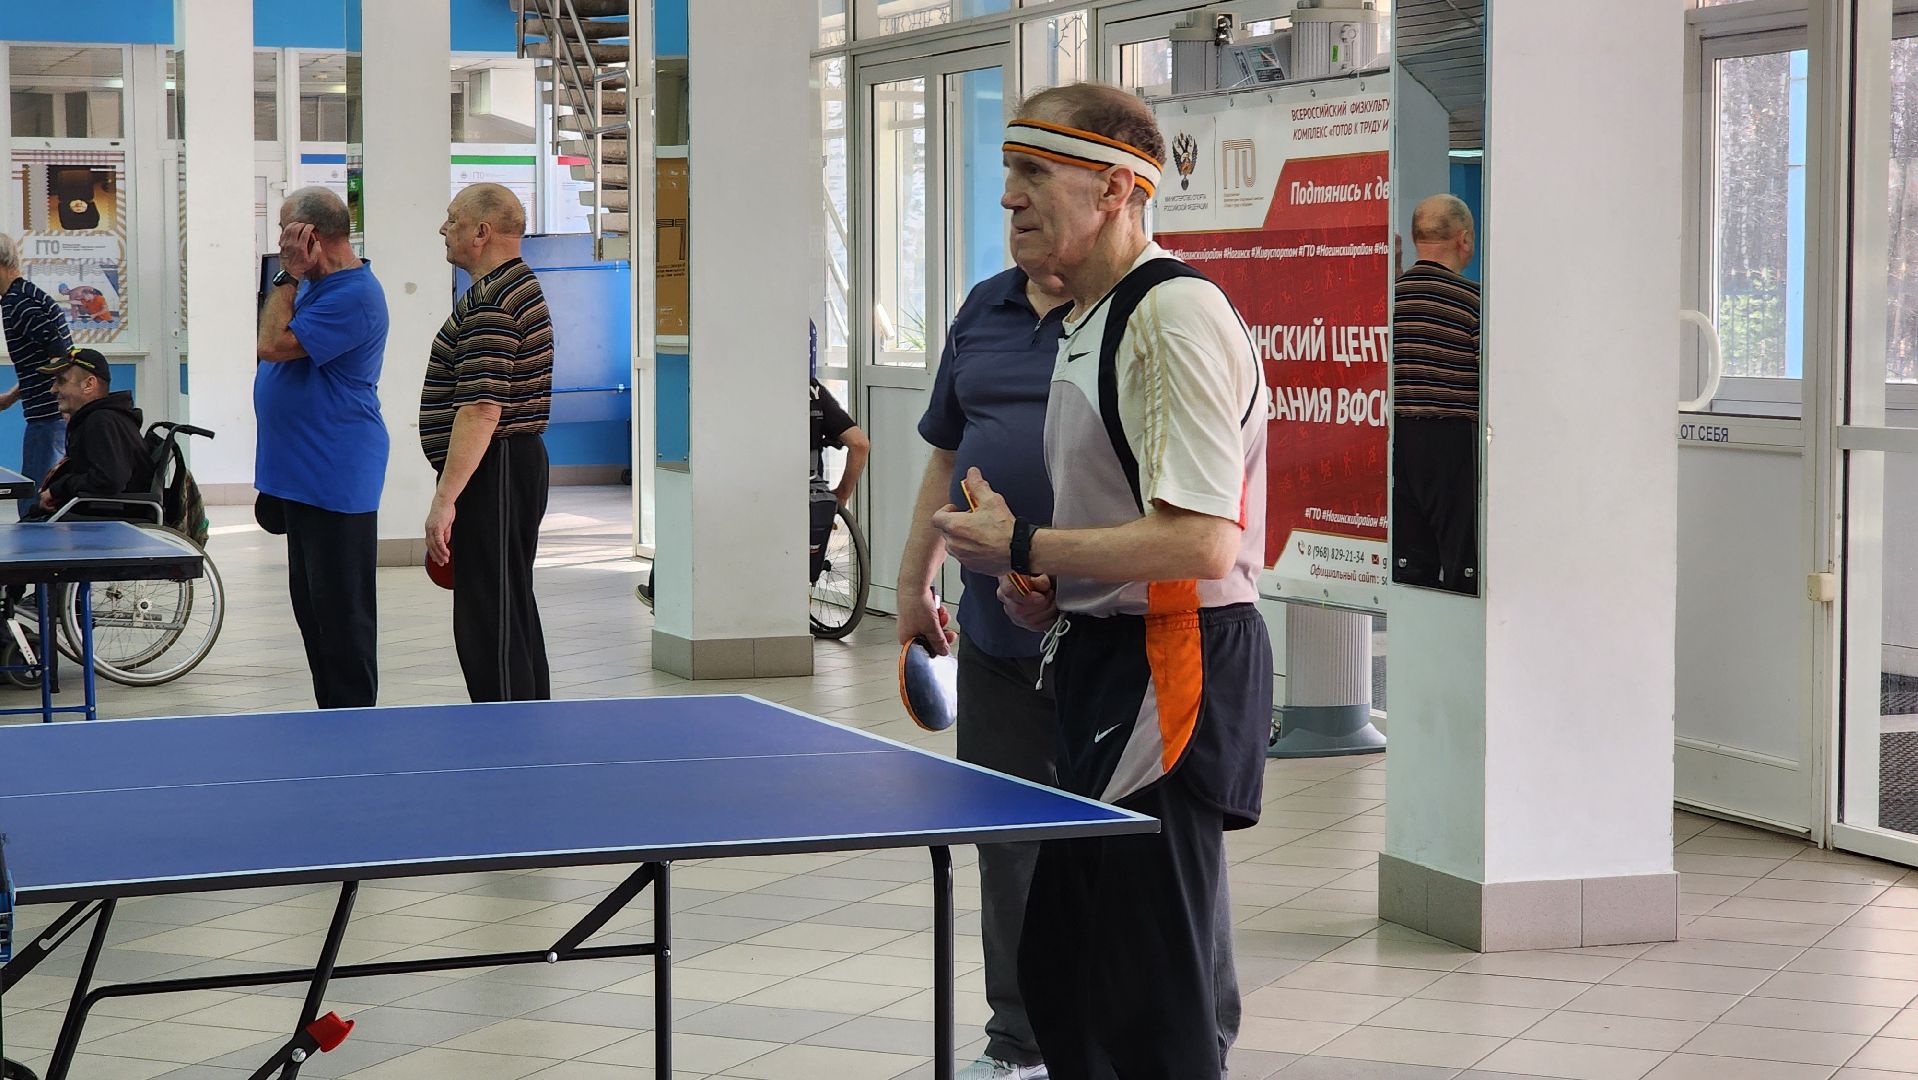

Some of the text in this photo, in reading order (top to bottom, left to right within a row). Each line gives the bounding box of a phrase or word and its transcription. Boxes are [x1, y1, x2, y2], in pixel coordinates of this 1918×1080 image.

[1291, 101, 1347, 121] ВСЕРОССИЙСКИЙ
[1293, 119, 1389, 141] КОМПЛЕКС «ГОТОВ К ТРУДУ И
[1222, 138, 1256, 189] ГТО
[1290, 180, 1362, 205] Подтянись
[1364, 182, 1373, 201] к
[1224, 247, 1251, 259] #Ногинск
[1299, 244, 1315, 257] #ГТО
[1316, 243, 1373, 258] #Ногинскийрайон
[1332, 326, 1388, 368] ЦЕНТ
[1681, 424, 1729, 443] ОТ СЕБЯ
[1304, 507, 1321, 521] #ГТО
[1307, 544, 1312, 556] 8
[1313, 545, 1330, 562] (968)
[1331, 548, 1365, 564] 829-21-34
[1310, 563, 1357, 582] Официальный
[1358, 571, 1380, 585] сайт:
